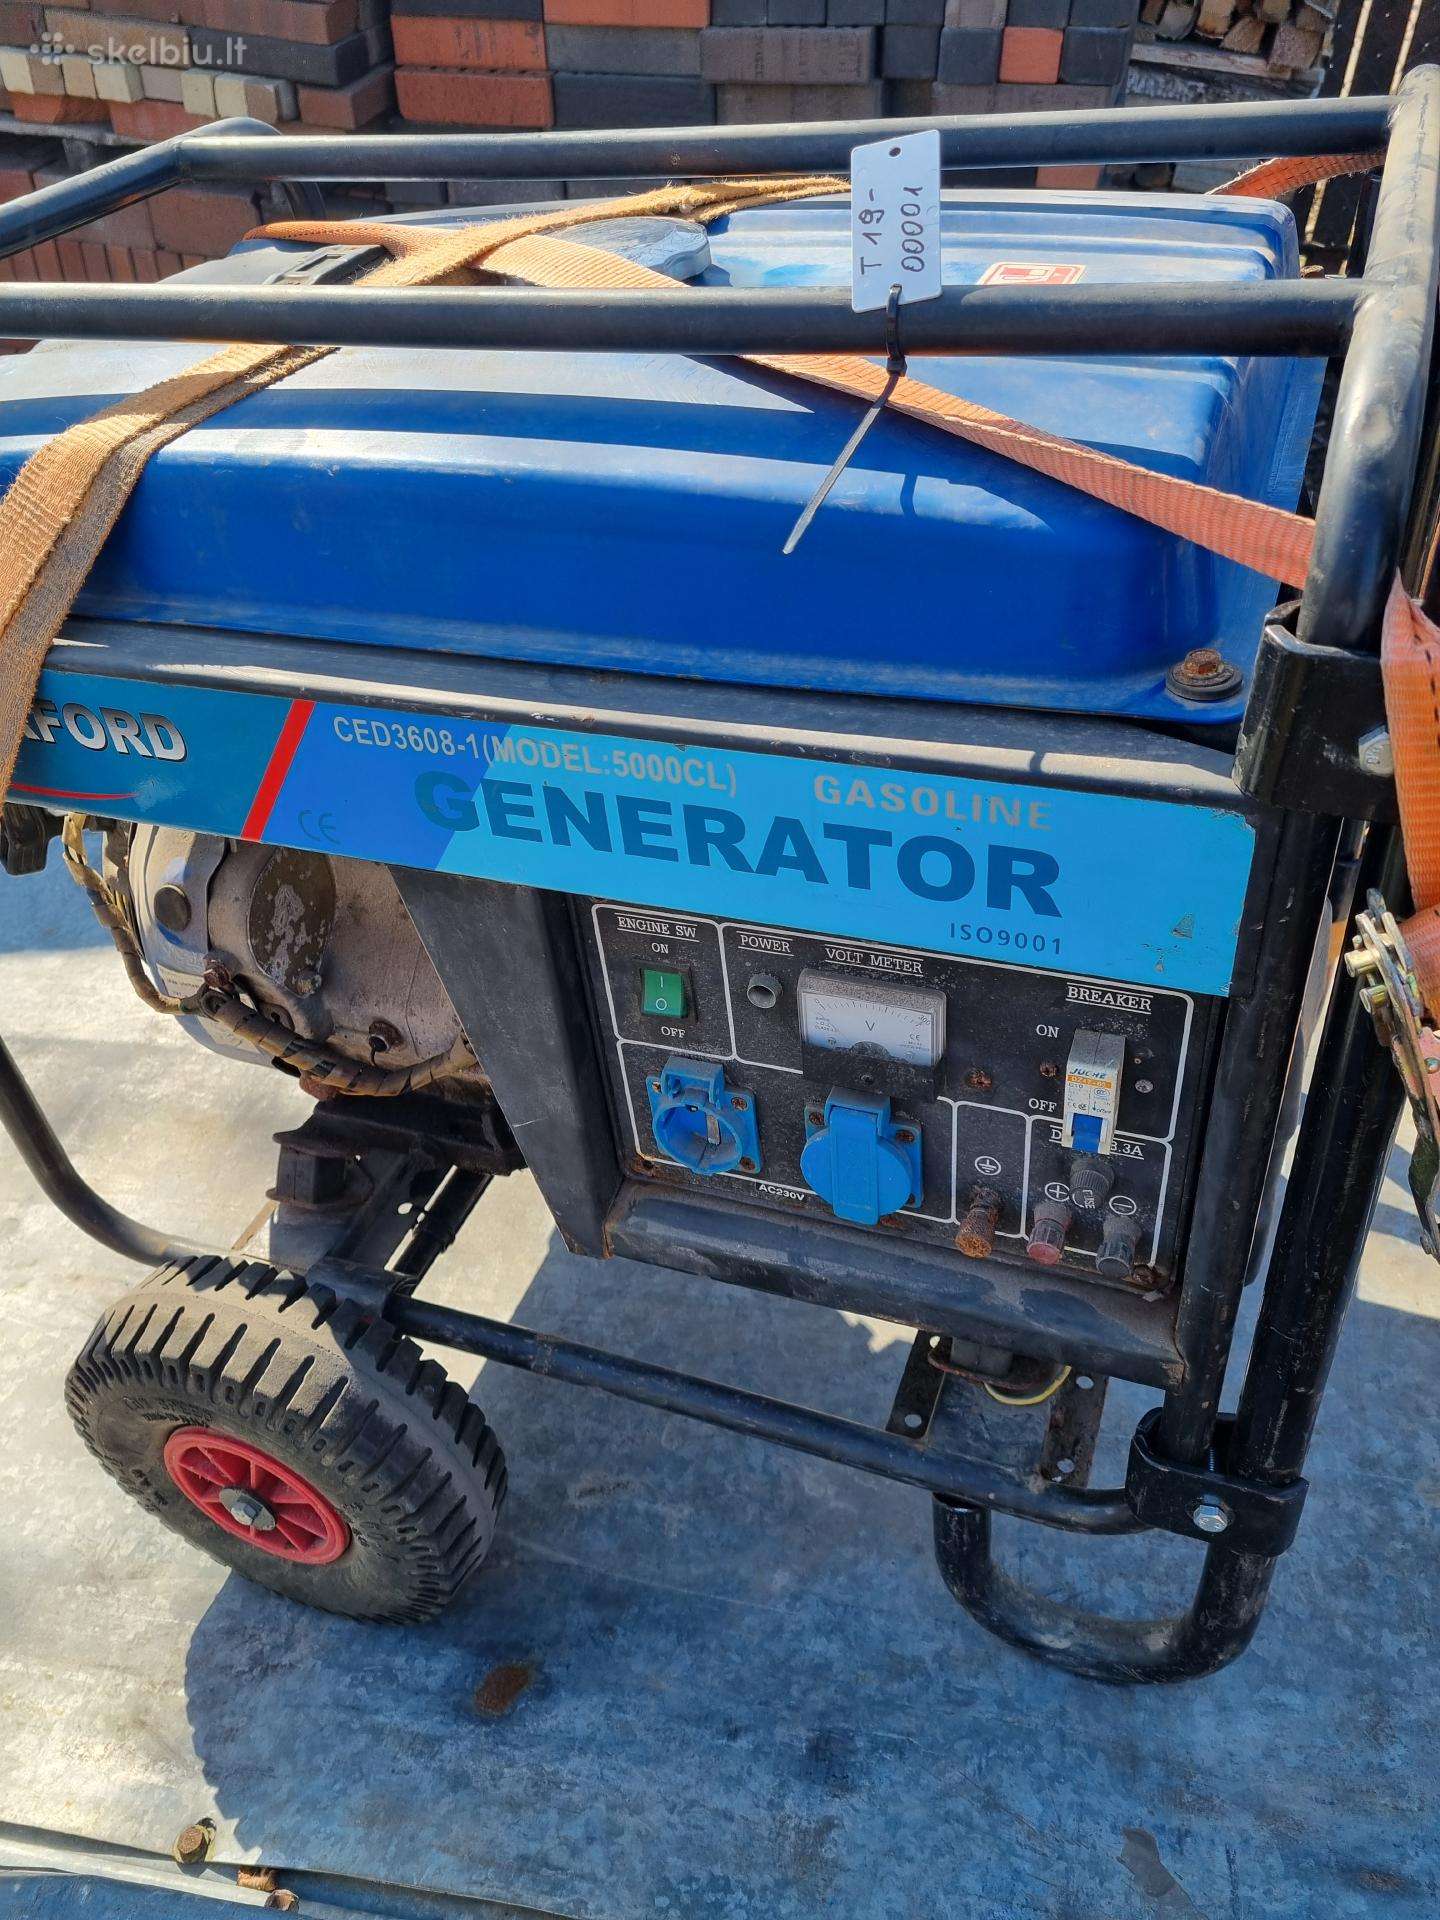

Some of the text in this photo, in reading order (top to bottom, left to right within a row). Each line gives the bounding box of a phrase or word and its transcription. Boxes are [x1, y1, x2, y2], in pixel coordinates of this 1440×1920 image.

[900, 186, 925, 272] 00001
[860, 257, 882, 275] T
[814, 774, 1054, 831] GASOLINE
[414, 770, 1064, 919] GENERATOR
[617, 916, 697, 939] ENGINE SW
[651, 942, 669, 954] ON
[740, 934, 792, 953] POWER
[949, 922, 1063, 956] ISO9001
[825, 947, 923, 974] VOLT METER
[1066, 985, 1153, 1012] BREAKER
[660, 1026, 686, 1039] OFF
[865, 1020, 876, 1031] V
[1036, 1024, 1060, 1039] ON
[1028, 1098, 1058, 1113] OFF
[758, 1183, 805, 1201] AC230V
